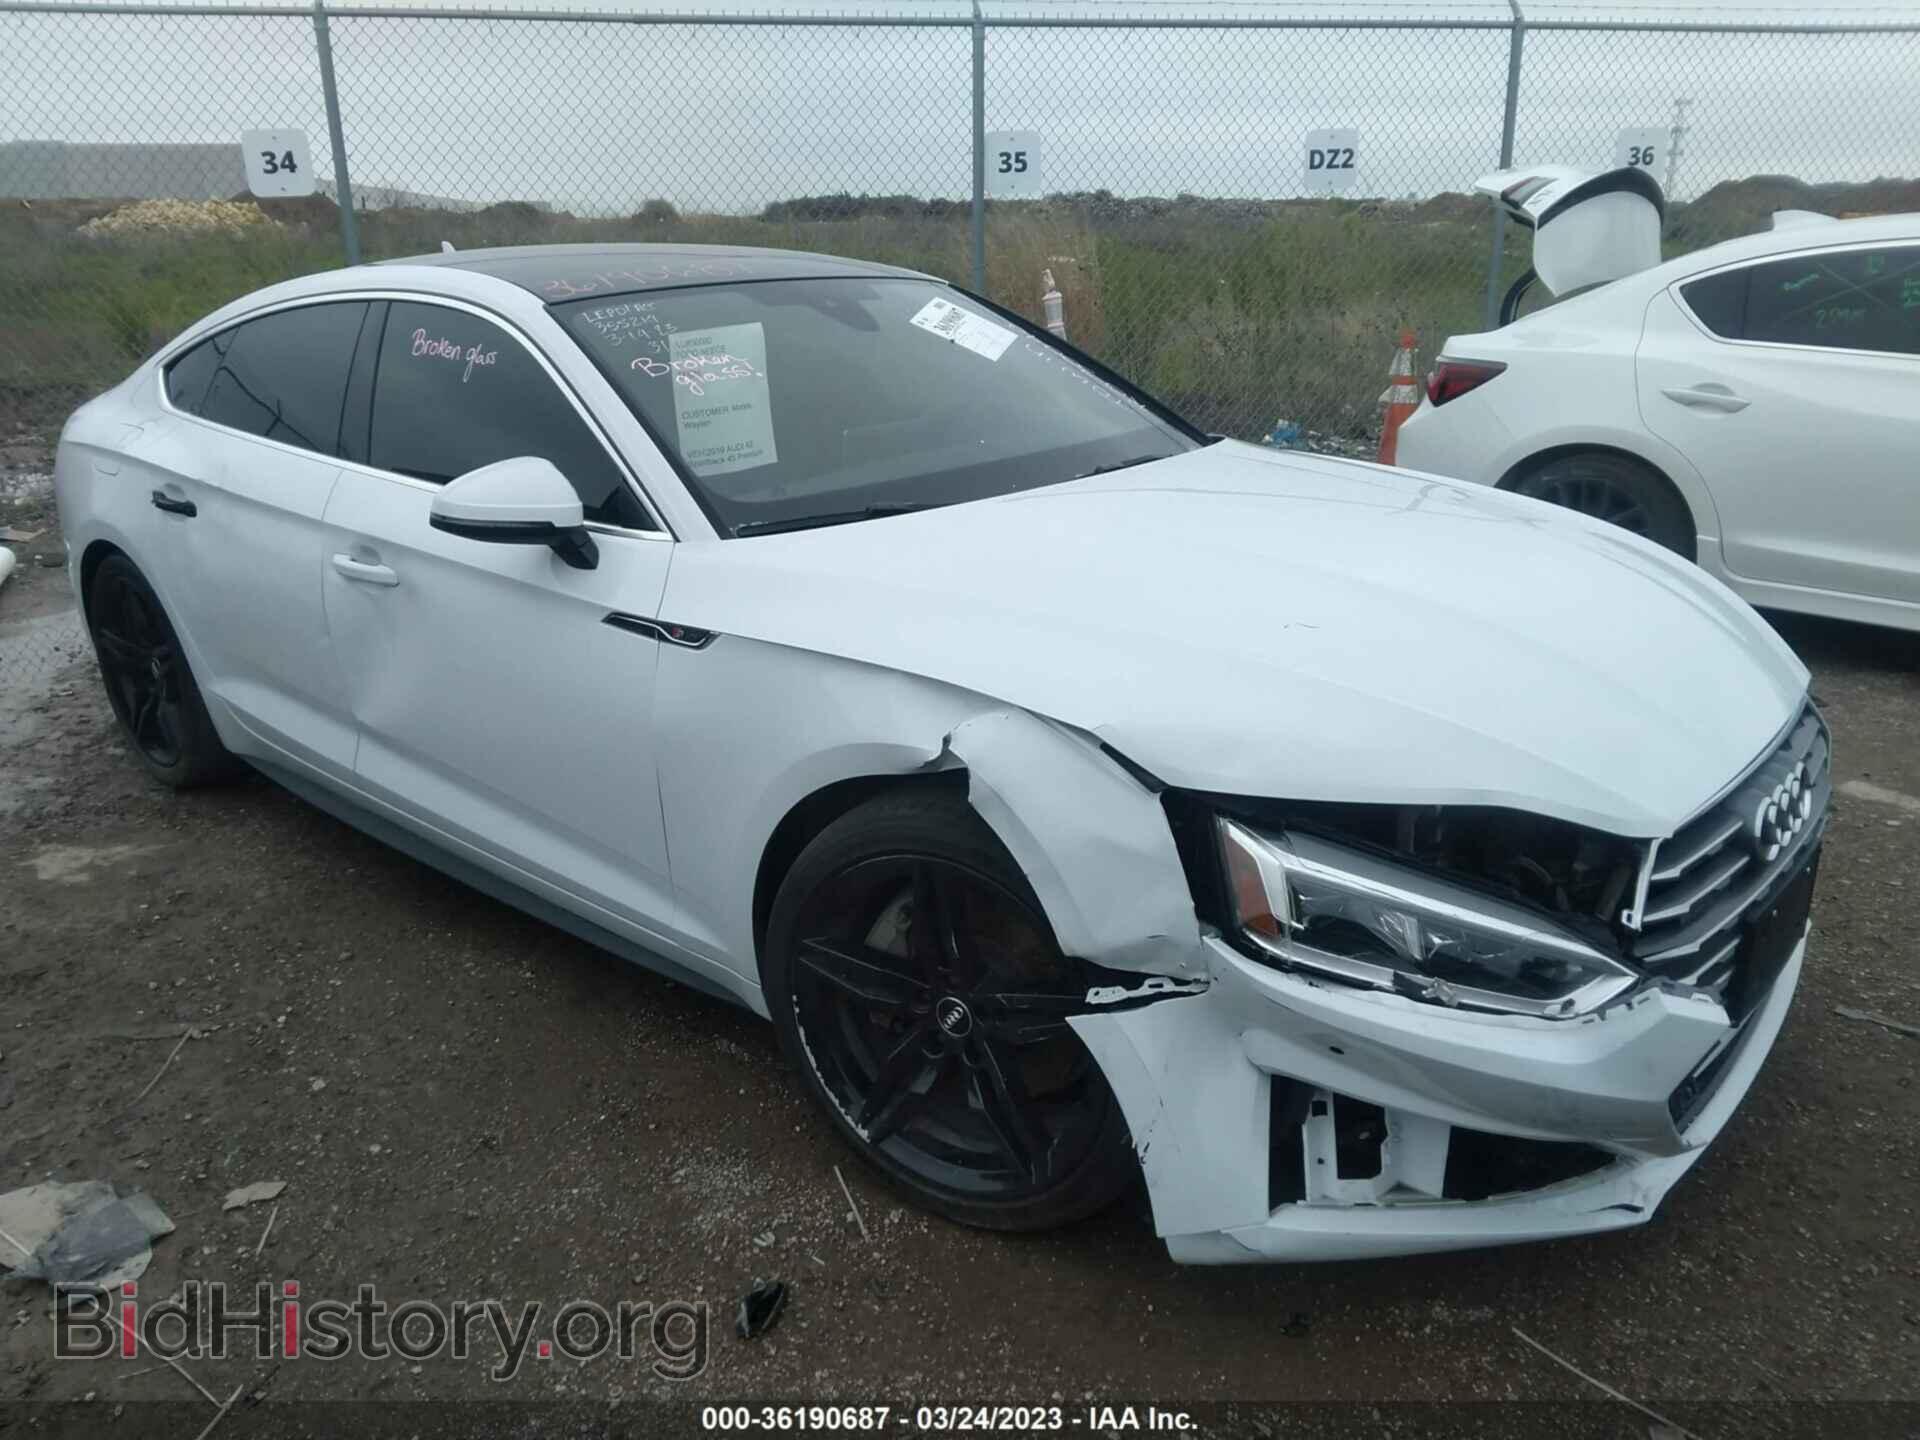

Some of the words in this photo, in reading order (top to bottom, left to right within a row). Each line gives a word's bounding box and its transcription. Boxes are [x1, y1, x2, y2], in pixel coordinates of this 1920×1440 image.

[261, 150, 298, 175] 34
[998, 151, 1028, 174] 35
[1309, 148, 1355, 170] DZ2
[1628, 145, 1655, 167] 36
[412, 328, 461, 360] Broken
